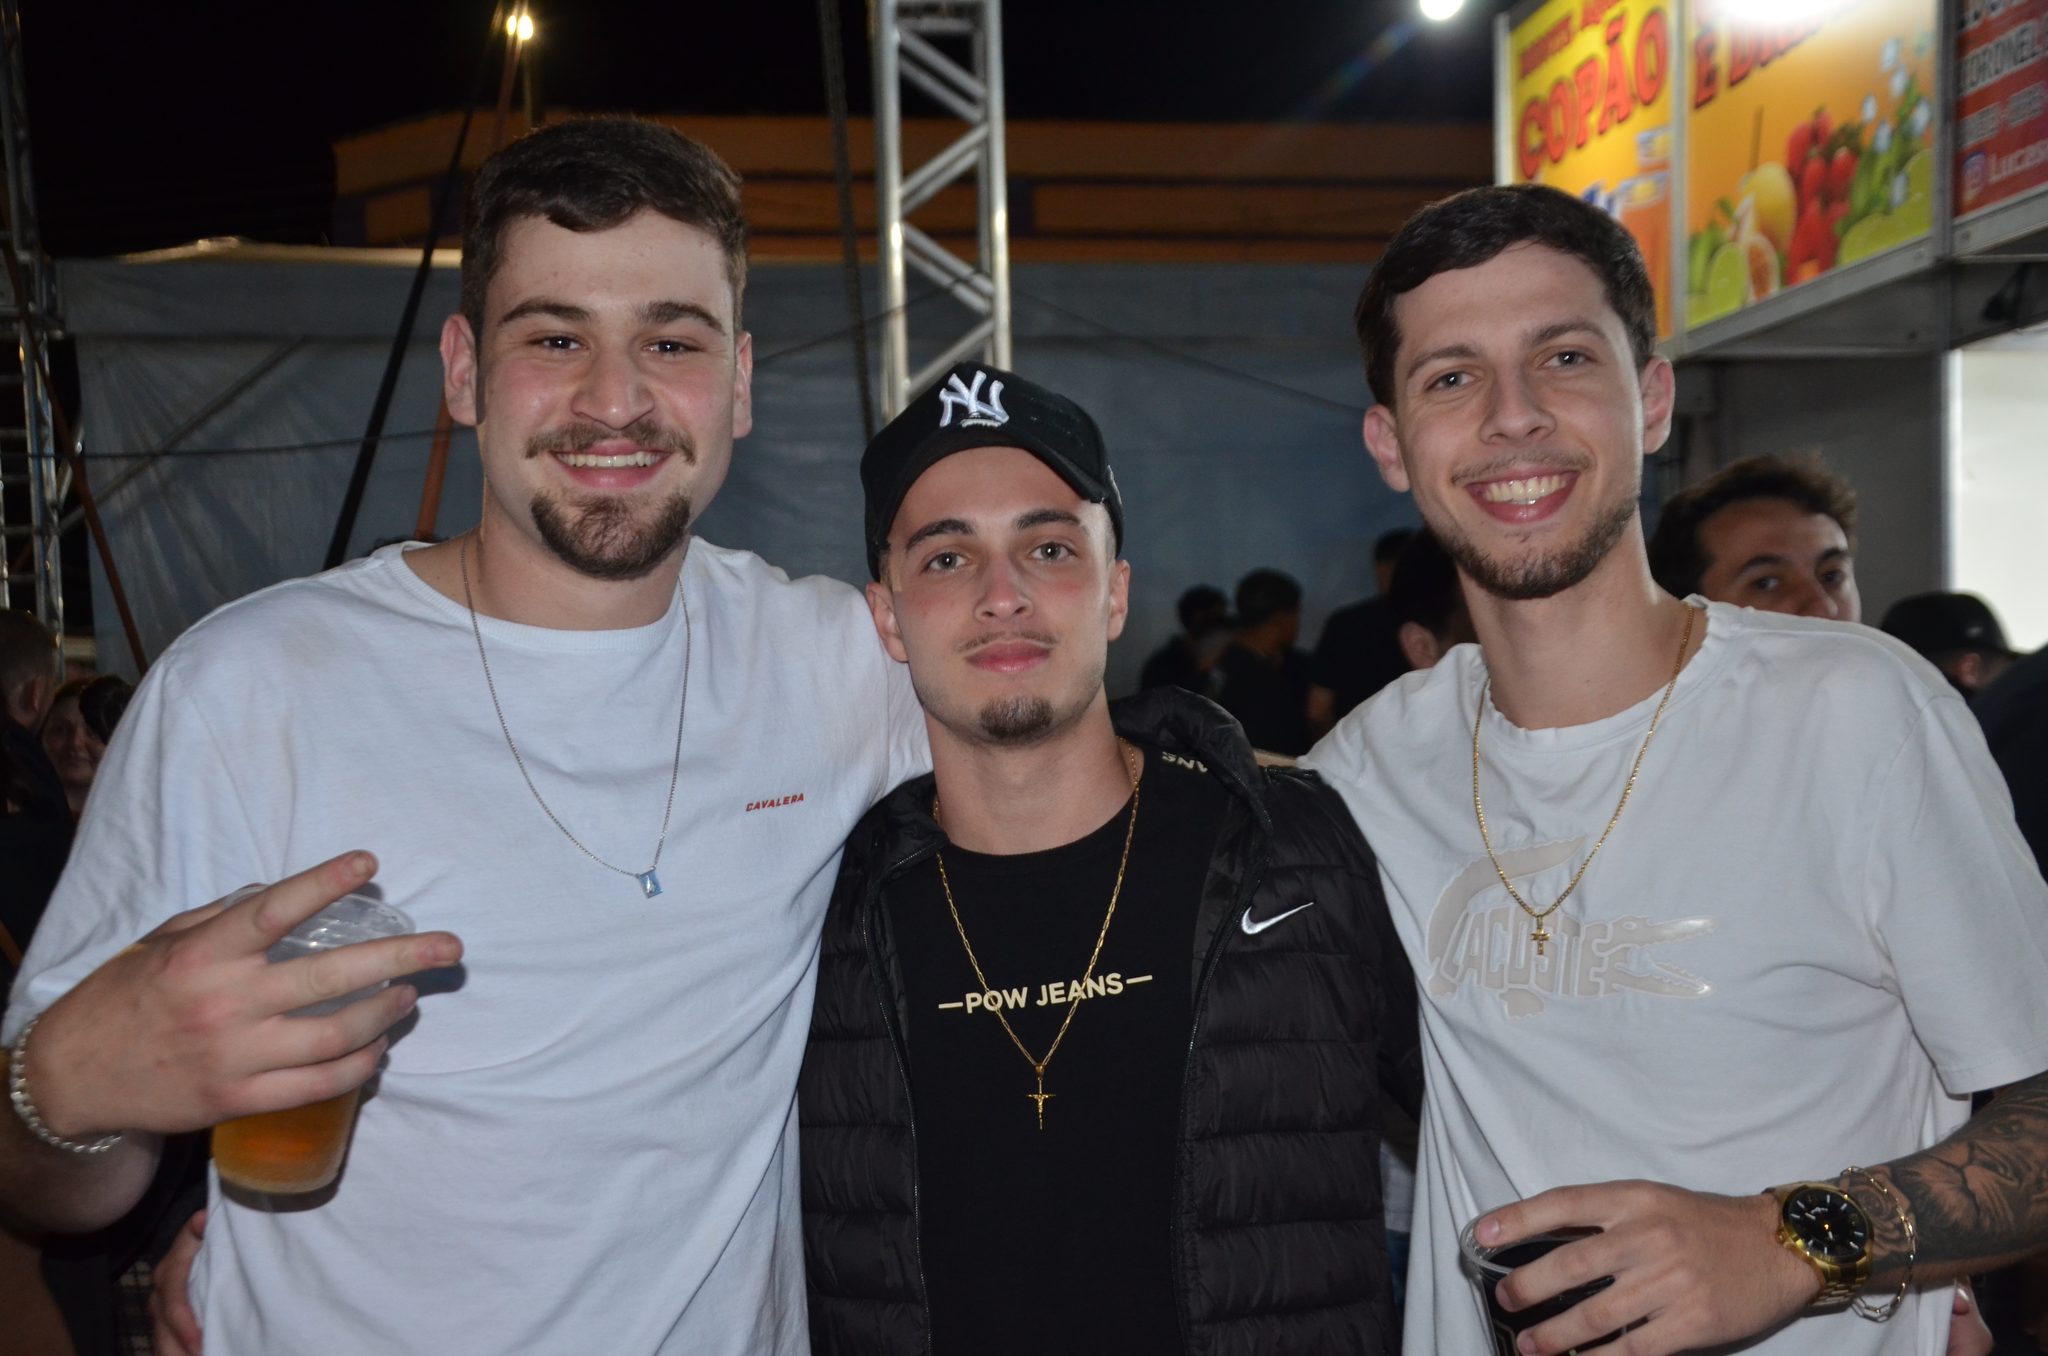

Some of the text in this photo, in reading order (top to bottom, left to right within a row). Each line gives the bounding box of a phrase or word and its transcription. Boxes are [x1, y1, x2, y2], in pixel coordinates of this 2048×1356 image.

[1519, 9, 1668, 179] COPÃO
[939, 370, 1010, 428] NY
[745, 792, 805, 812] CAVALERA
[965, 972, 1124, 1014] POW JEANS
